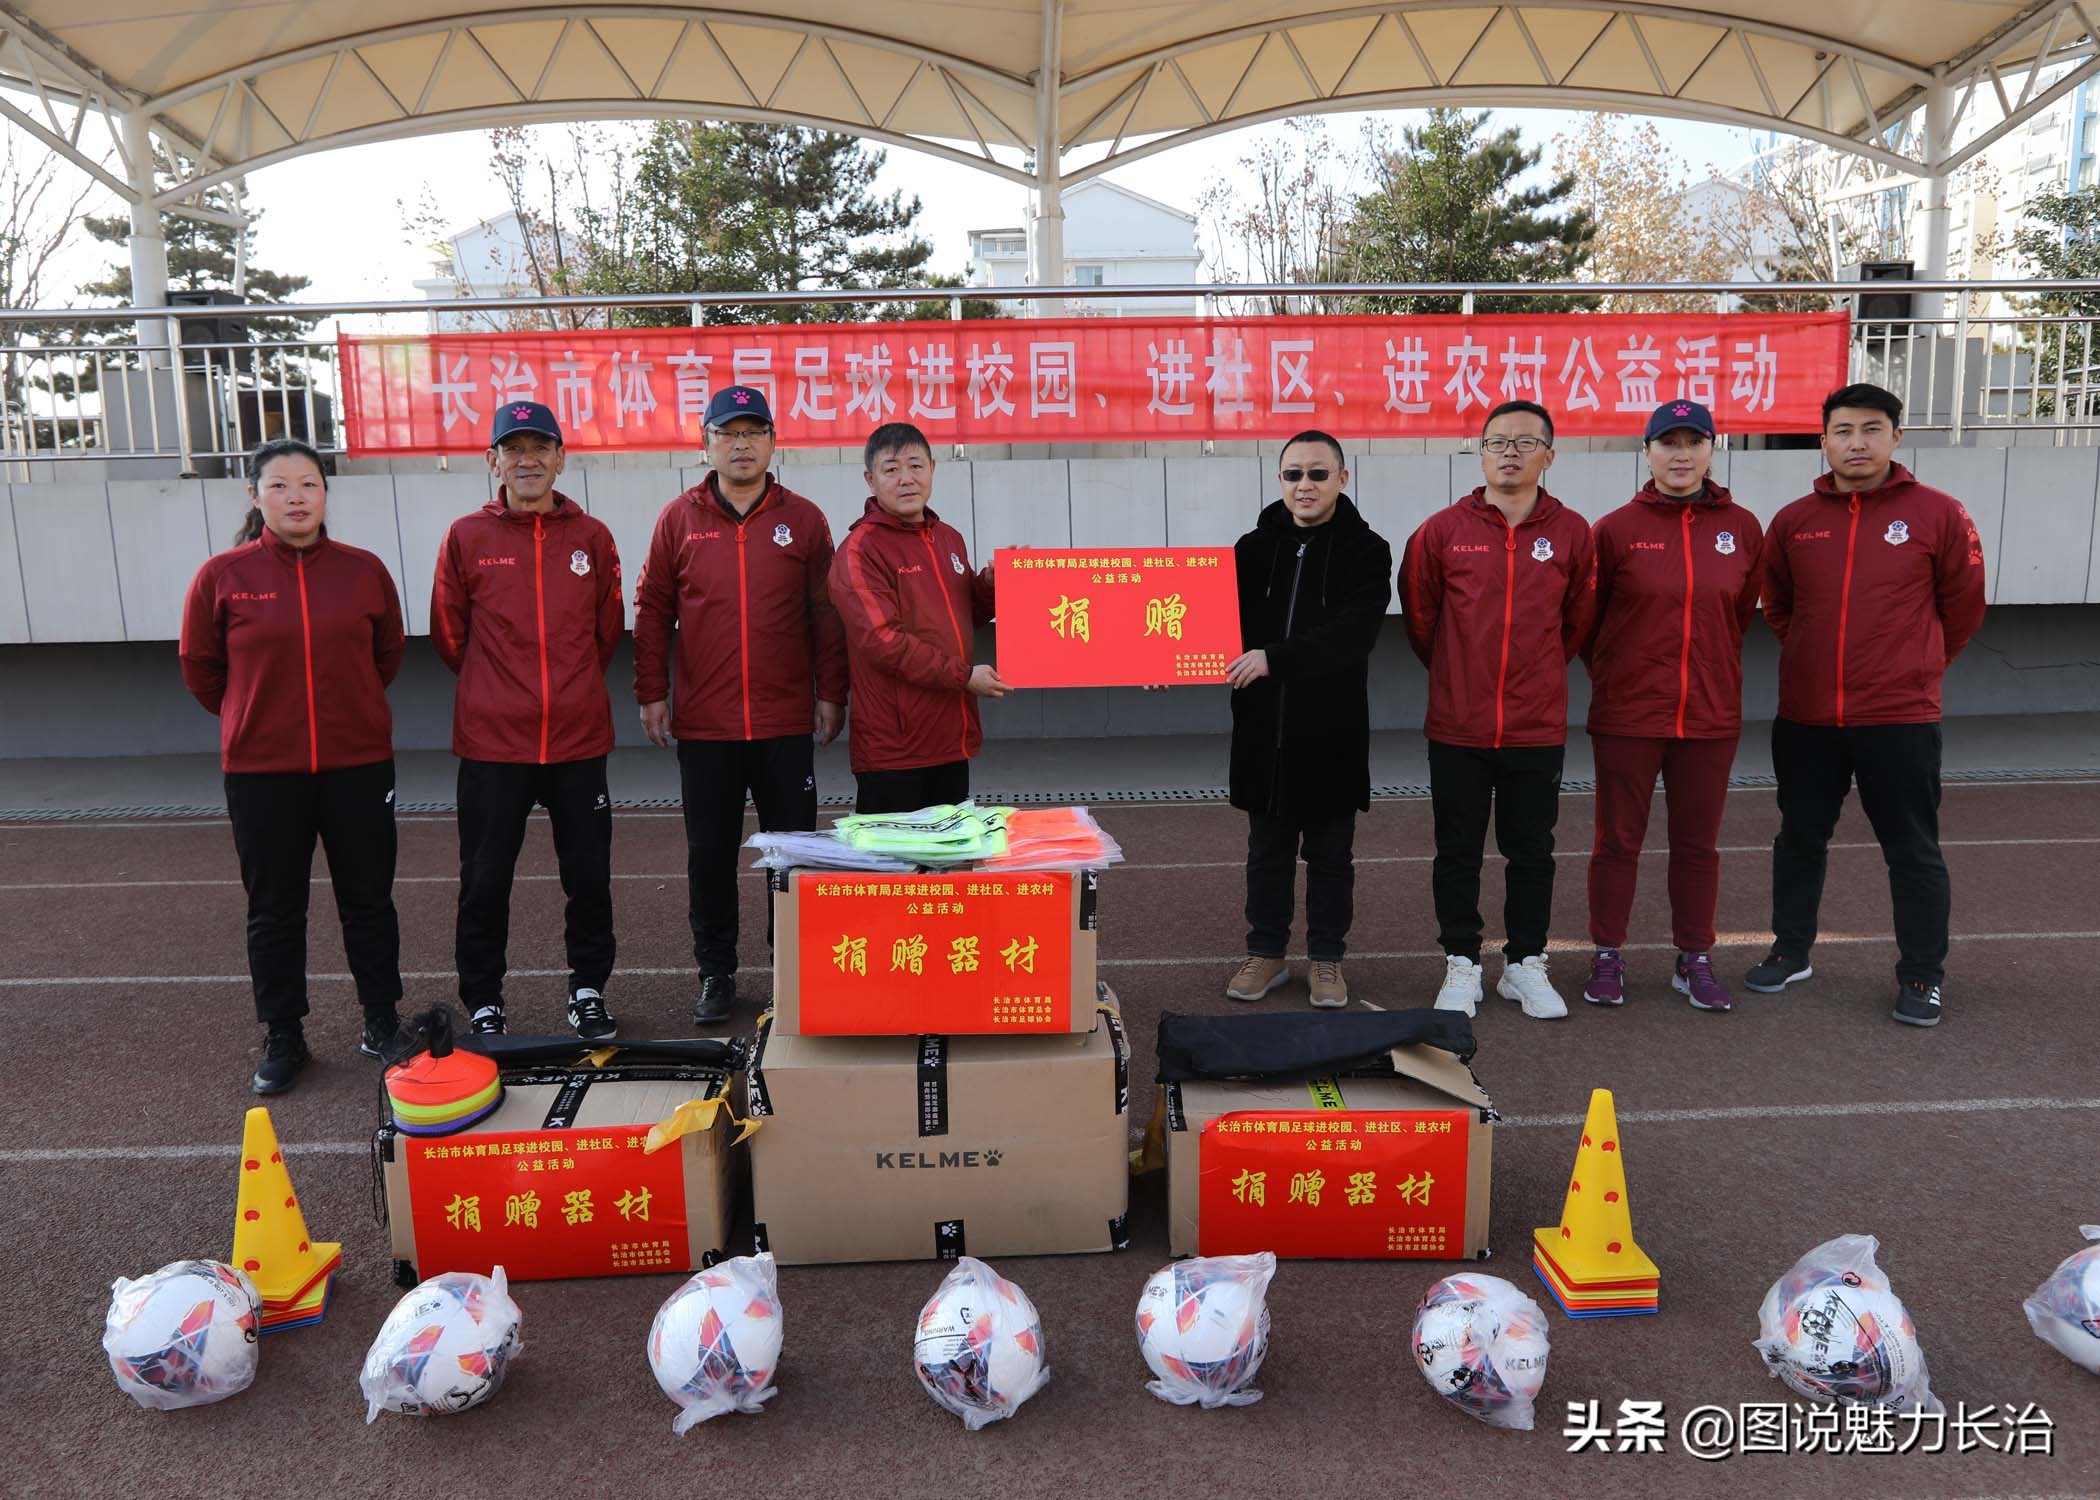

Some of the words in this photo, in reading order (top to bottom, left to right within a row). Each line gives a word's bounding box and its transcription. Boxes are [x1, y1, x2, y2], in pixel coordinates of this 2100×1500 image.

[1453, 545, 1490, 553] KELME
[478, 557, 517, 566] KELME
[1011, 556, 1219, 569] 长治市体育局足球进校园、进社区、进农村
[1091, 573, 1143, 584] 公益活动
[232, 592, 278, 601] KELME
[1048, 593, 1188, 644] 捐赠
[815, 882, 1055, 897] 长治市体育局足球进校园、进社区、进农村
[906, 902, 965, 915] 公益活动
[831, 933, 1040, 977] 捐赠器材
[1216, 1120, 1452, 1134] 长治市体育局足球进校园、进社区、进农村
[1305, 1138, 1363, 1152] 公益活动
[516, 1157, 575, 1172] 公益活动
[875, 1151, 980, 1169] KELME
[1231, 1168, 1436, 1208] 捐赠器材
[444, 1185, 654, 1233] 捐赠器材
